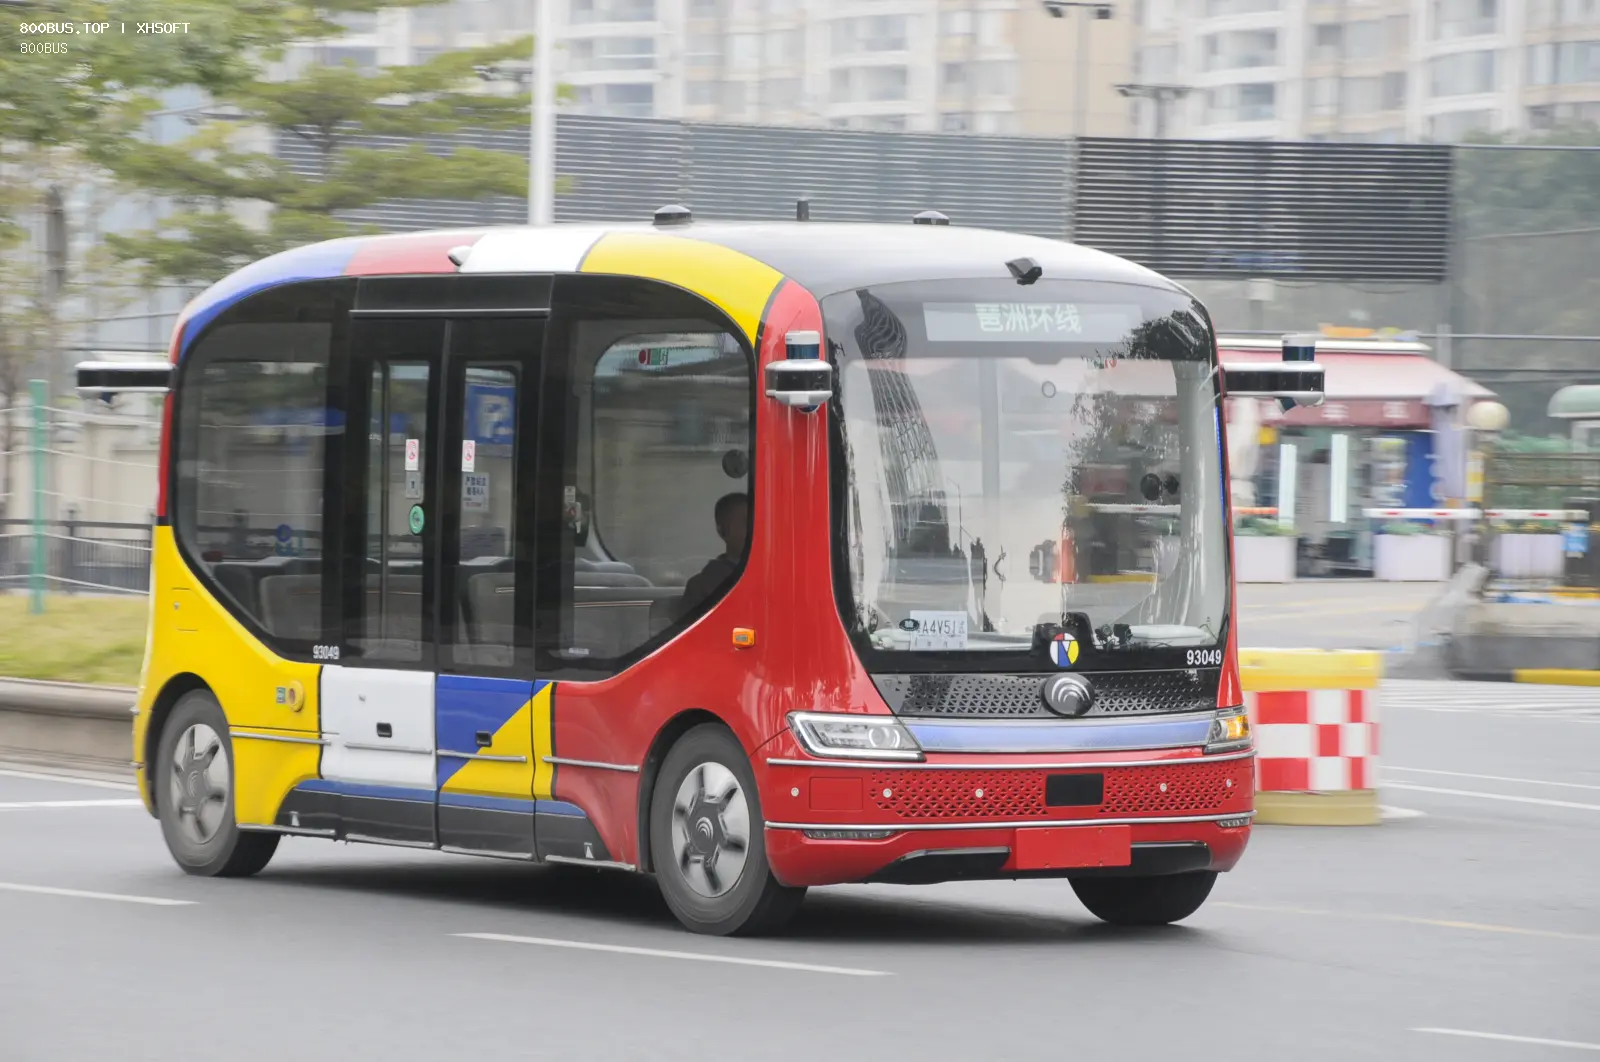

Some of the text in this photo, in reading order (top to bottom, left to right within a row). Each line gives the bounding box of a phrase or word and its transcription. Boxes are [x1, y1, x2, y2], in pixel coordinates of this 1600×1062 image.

[974, 303, 1082, 334] 琶洲环线
[312, 644, 340, 660] 93049
[1186, 649, 1222, 666] 93049
